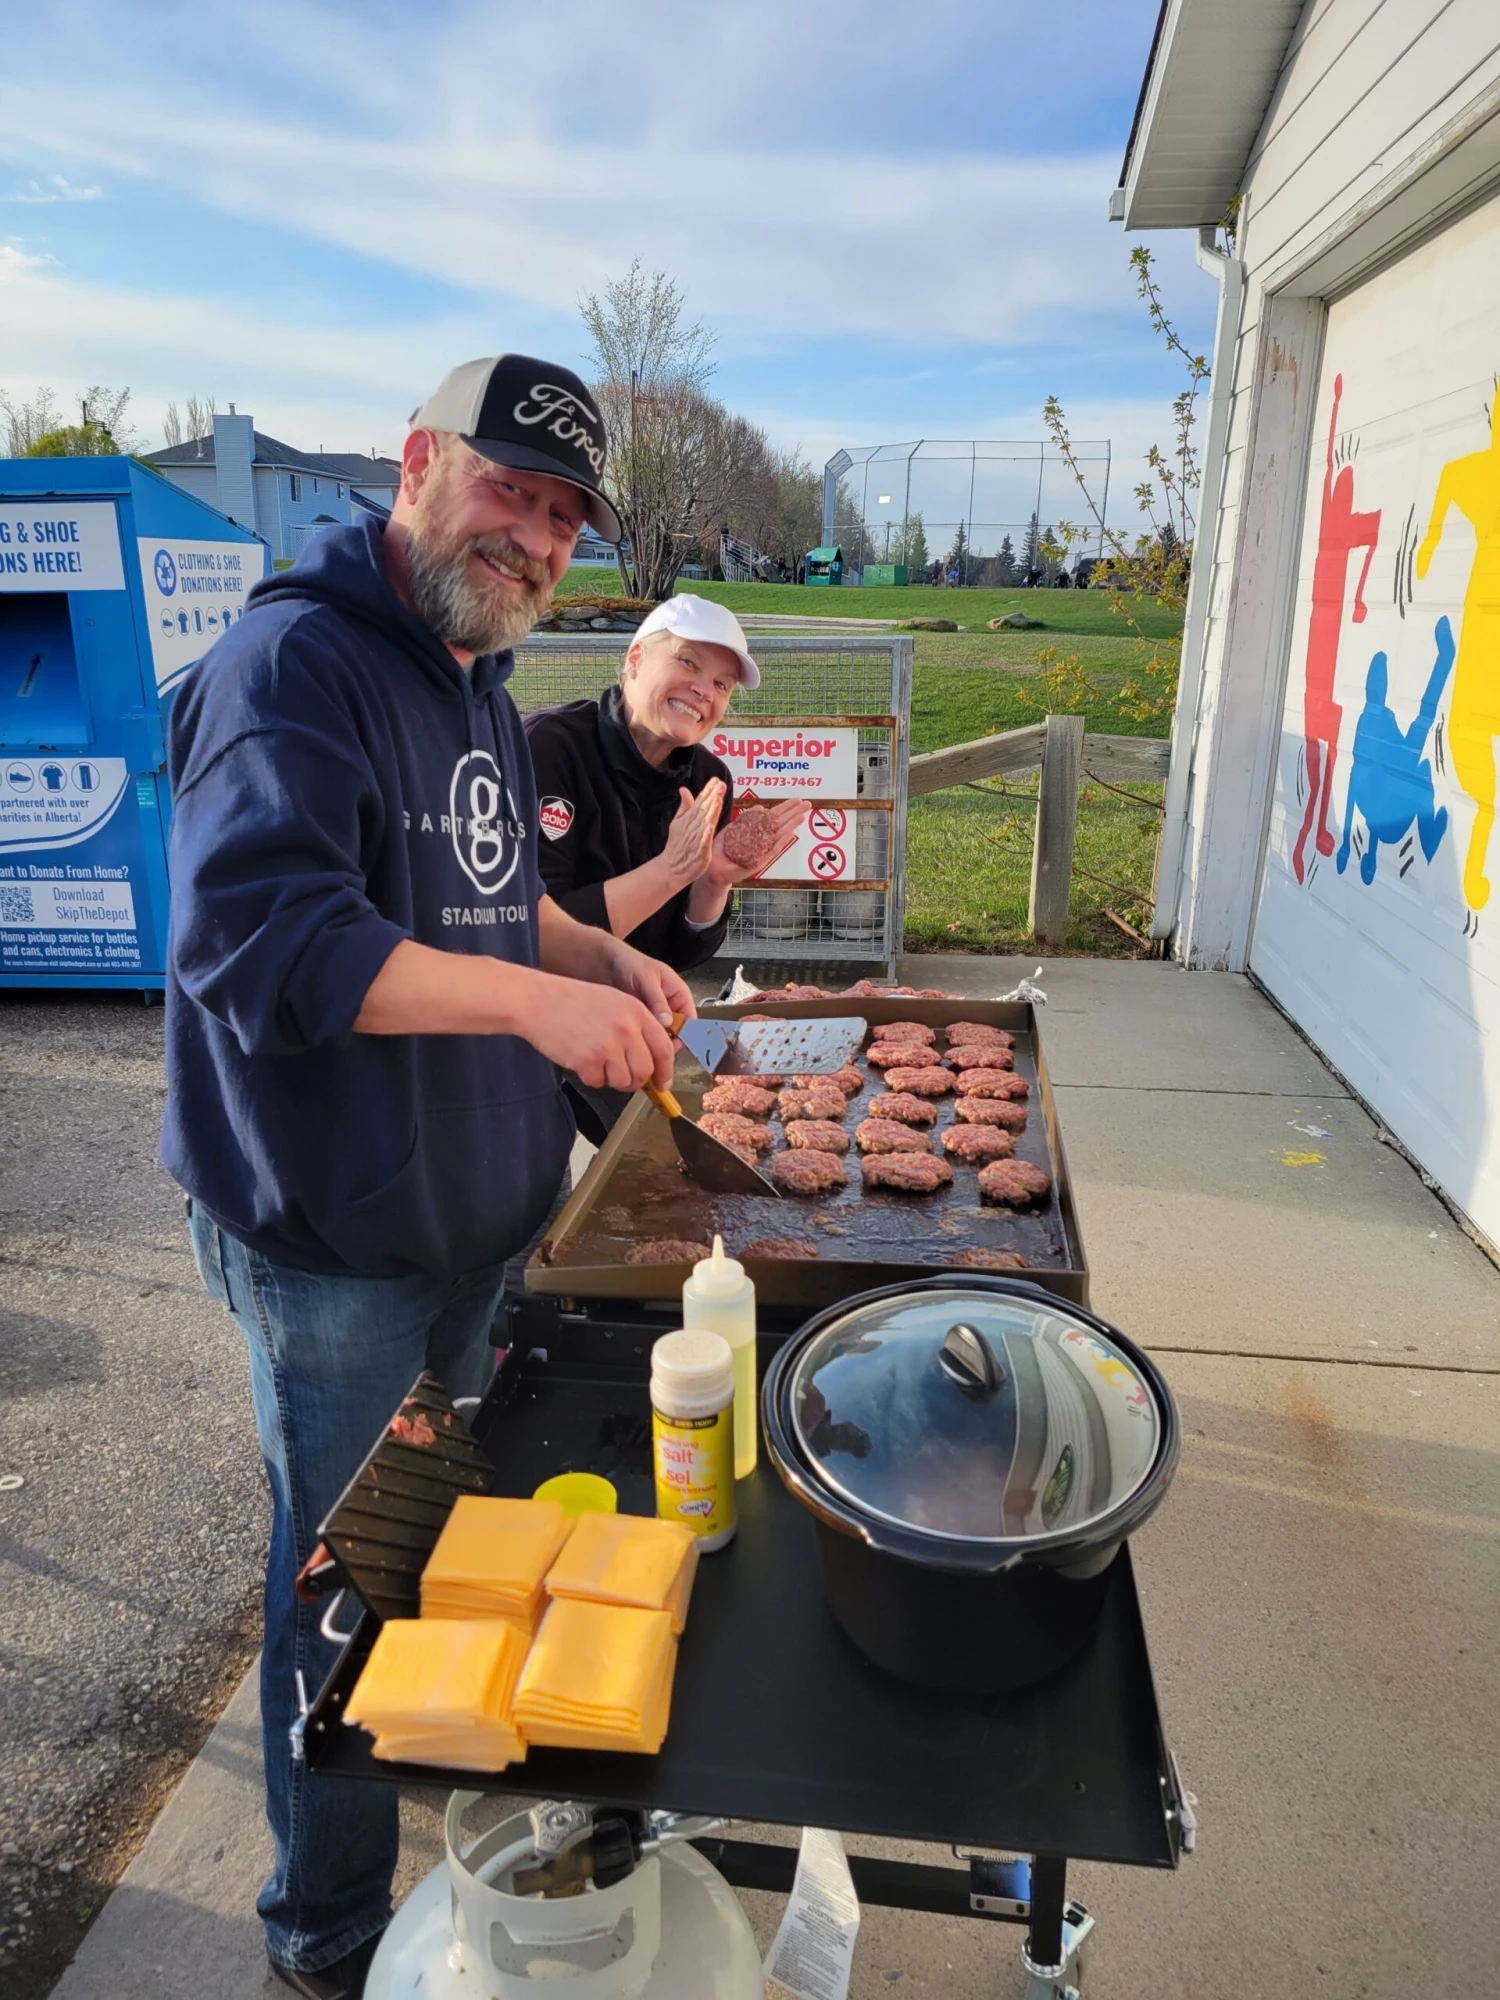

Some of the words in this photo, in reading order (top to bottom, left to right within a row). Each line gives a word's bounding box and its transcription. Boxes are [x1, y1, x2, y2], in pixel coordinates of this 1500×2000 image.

[513, 384, 605, 475] Ford
[17, 522, 29, 543] &
[33, 521, 80, 543] SHOE
[32, 551, 82, 573] HERE!
[178, 553, 215, 570] CLOTHING
[216, 555, 222, 570] &
[223, 555, 242, 571] SHOE
[181, 576, 222, 593] DONATIONS
[223, 577, 243, 592] HERE!
[713, 733, 836, 768] Superior
[756, 759, 809, 772] Propane
[733, 776, 822, 787] -877-873-7467
[1, 797, 45, 810] partnered
[47, 797, 67, 808] with
[69, 799, 89, 808] over
[33, 812, 43, 822] in
[45, 812, 82, 823] Alberta!
[541, 811, 568, 828] 2010
[17, 866, 28, 878] to
[29, 865, 65, 878] Donate
[66, 865, 92, 879] From
[93, 866, 129, 879] Home?
[53, 887, 105, 901] Download
[55, 906, 130, 923] SkipTheDepot
[441, 906, 497, 926] STADIUM
[0, 930, 26, 942] Home
[28, 931, 57, 945] pickup
[58, 931, 90, 943] service
[91, 932, 104, 944] for
[106, 932, 138, 944] bottles
[3, 944, 19, 956] and
[20, 947, 44, 958] cans,
[45, 945, 93, 957] electronics
[94, 945, 103, 957] &
[104, 945, 141, 960] clothing
[663, 1447, 694, 1465] salt
[666, 1469, 691, 1485] sel
